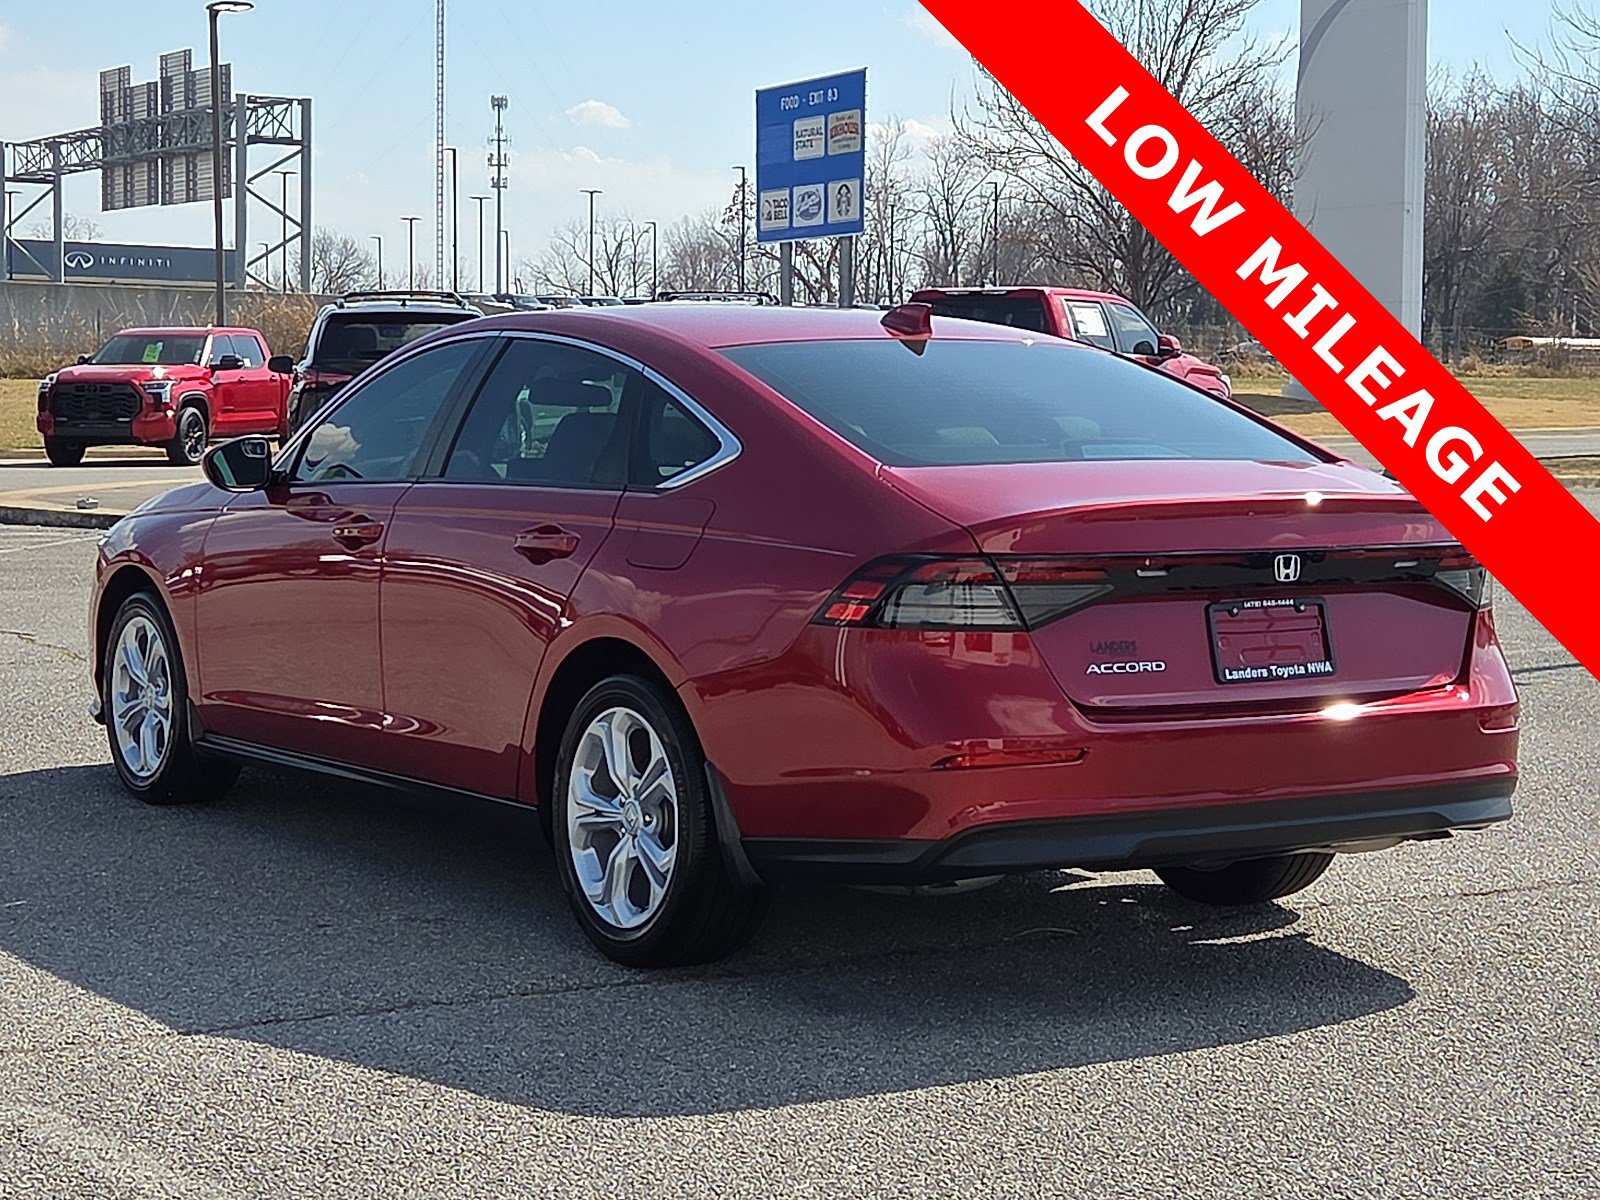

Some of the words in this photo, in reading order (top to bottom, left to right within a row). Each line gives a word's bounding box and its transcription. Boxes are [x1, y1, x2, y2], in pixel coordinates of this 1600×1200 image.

[781, 95, 799, 111] FOOD
[809, 90, 824, 105] EXIT
[795, 126, 823, 138] NATURAL
[795, 138, 814, 150] STATE
[773, 197, 788, 209] TACO
[773, 209, 788, 221] BELL
[100, 256, 171, 268] INFINITI
[1086, 661, 1167, 675] ACCORD
[1225, 667, 1268, 680] Landers
[1270, 664, 1306, 678] Toyota
[1307, 661, 1333, 673] NWA
